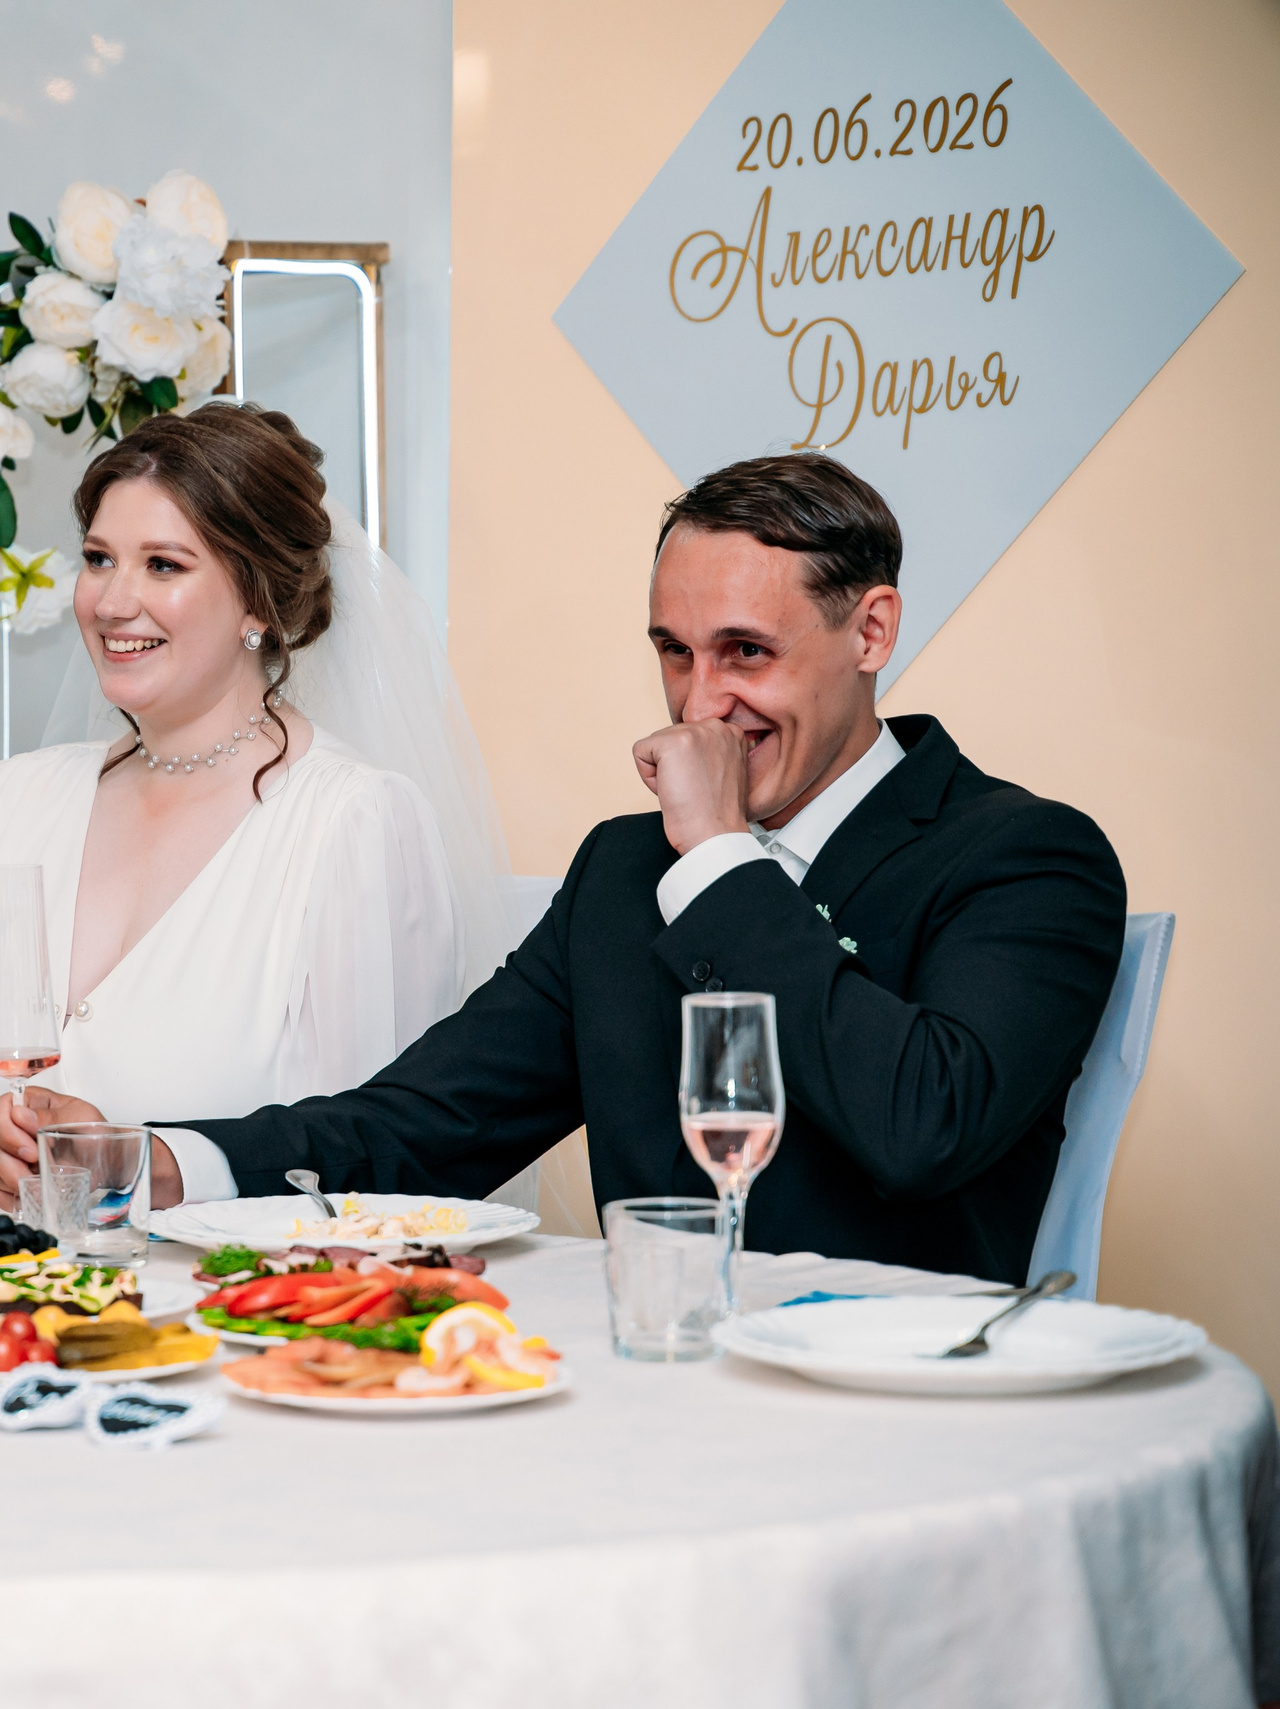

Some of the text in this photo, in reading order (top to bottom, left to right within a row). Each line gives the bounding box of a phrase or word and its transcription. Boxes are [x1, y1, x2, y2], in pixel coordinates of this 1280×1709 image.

[735, 78, 1014, 173] 20.06.2026
[668, 186, 1056, 338] Александр
[787, 317, 1020, 452] Дарья
